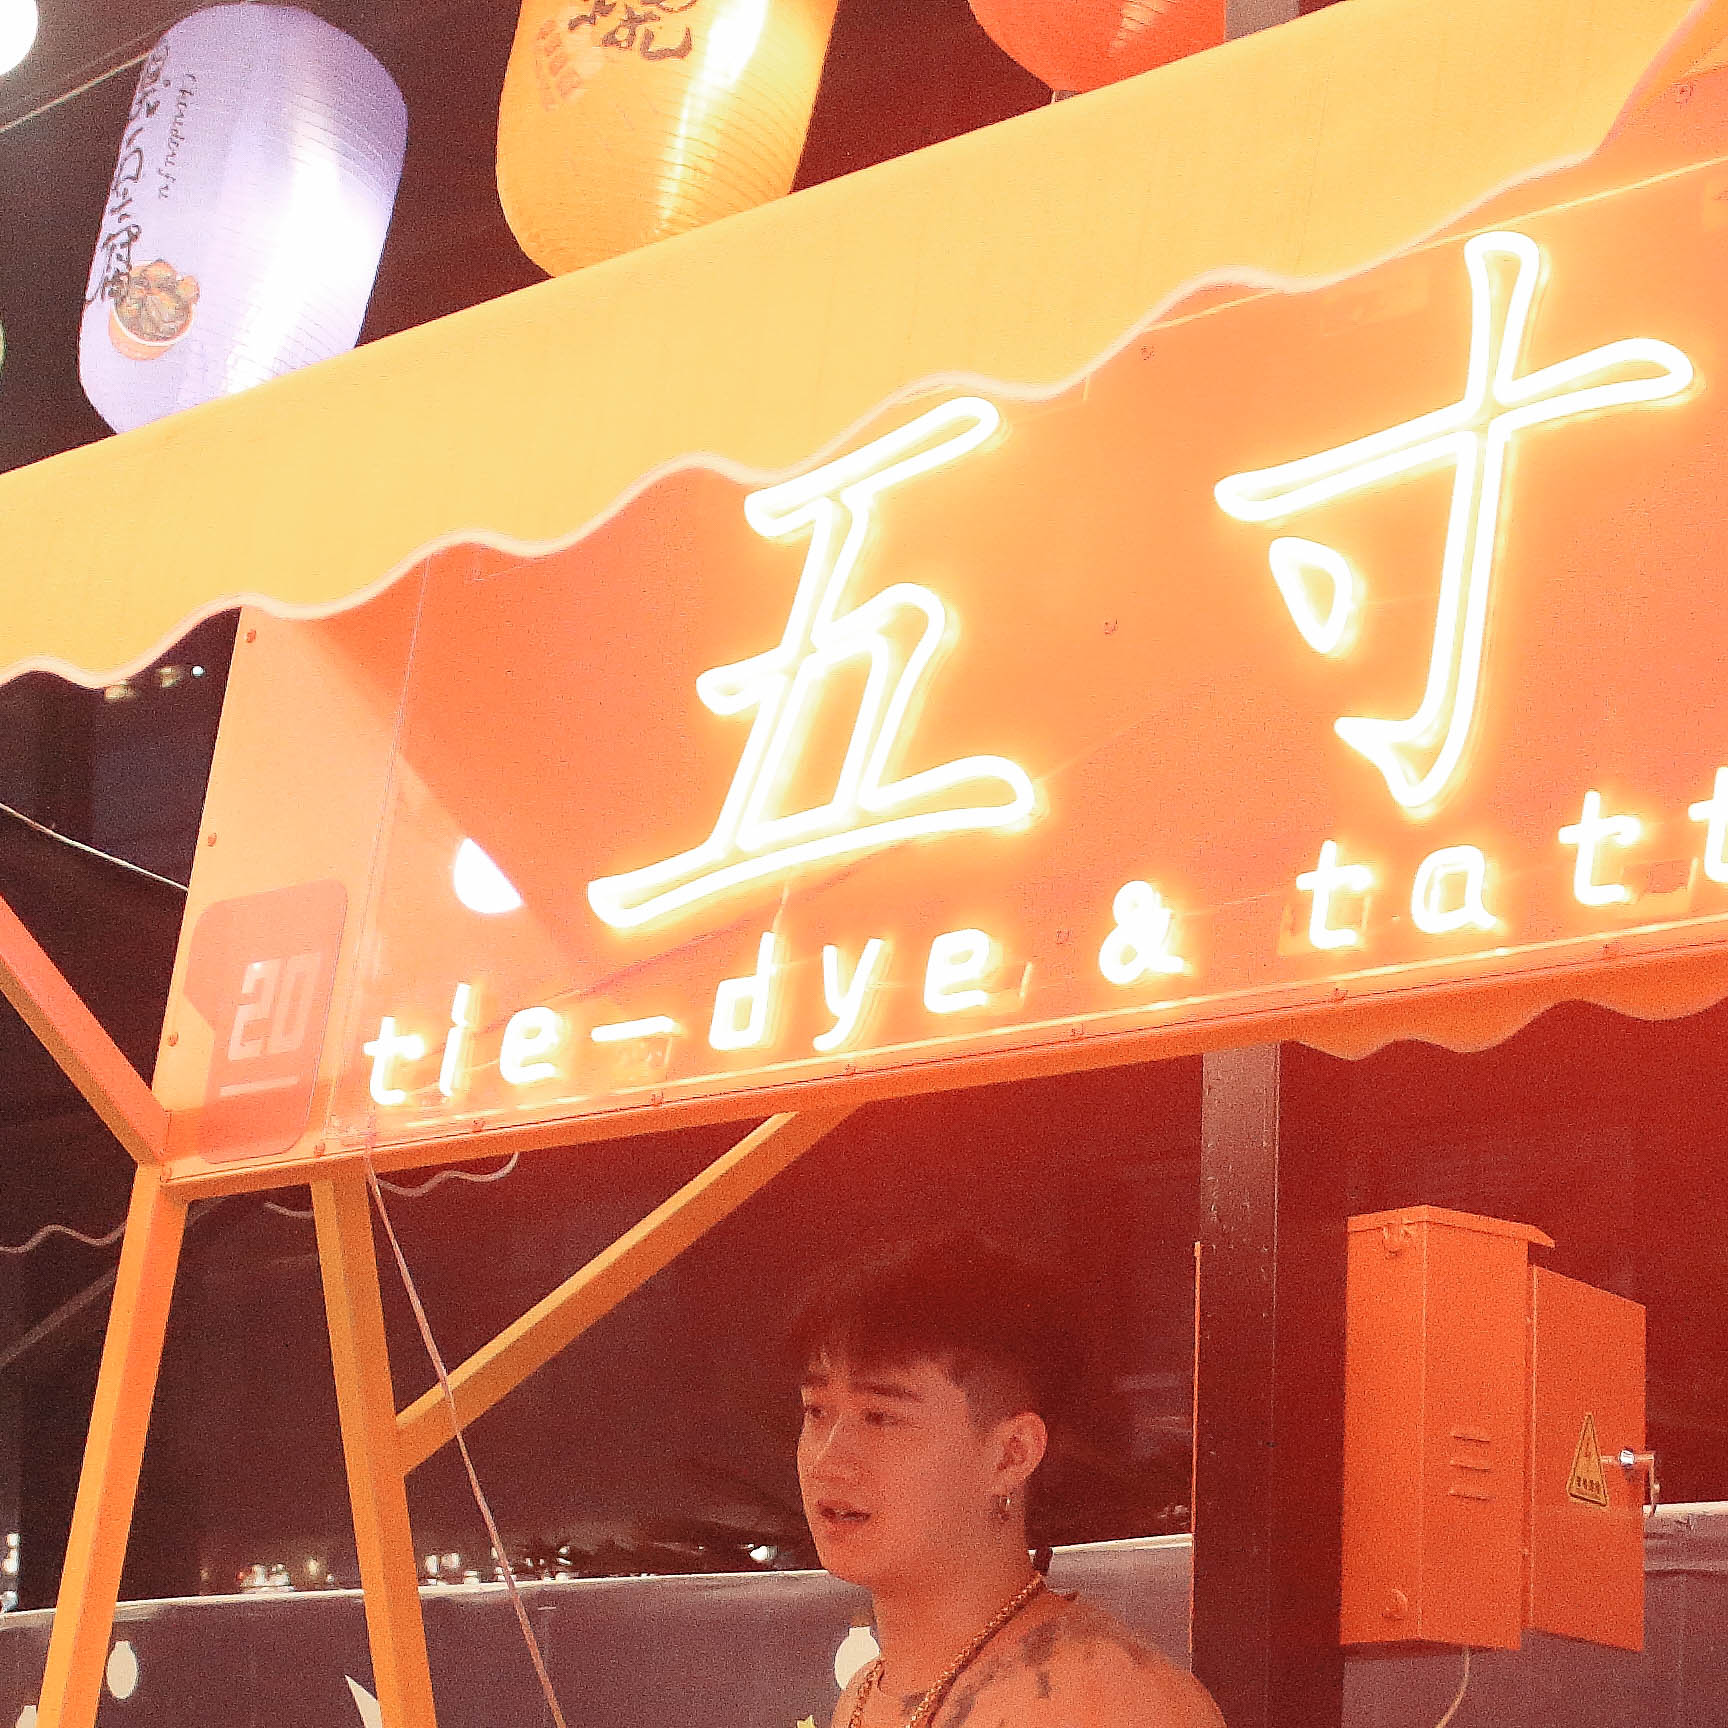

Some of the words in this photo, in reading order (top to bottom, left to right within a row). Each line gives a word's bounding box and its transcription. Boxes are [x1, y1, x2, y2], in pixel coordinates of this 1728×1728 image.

[586, 228, 1696, 930] 五寸
[1098, 878, 1186, 986] &
[228, 954, 322, 1062] 20
